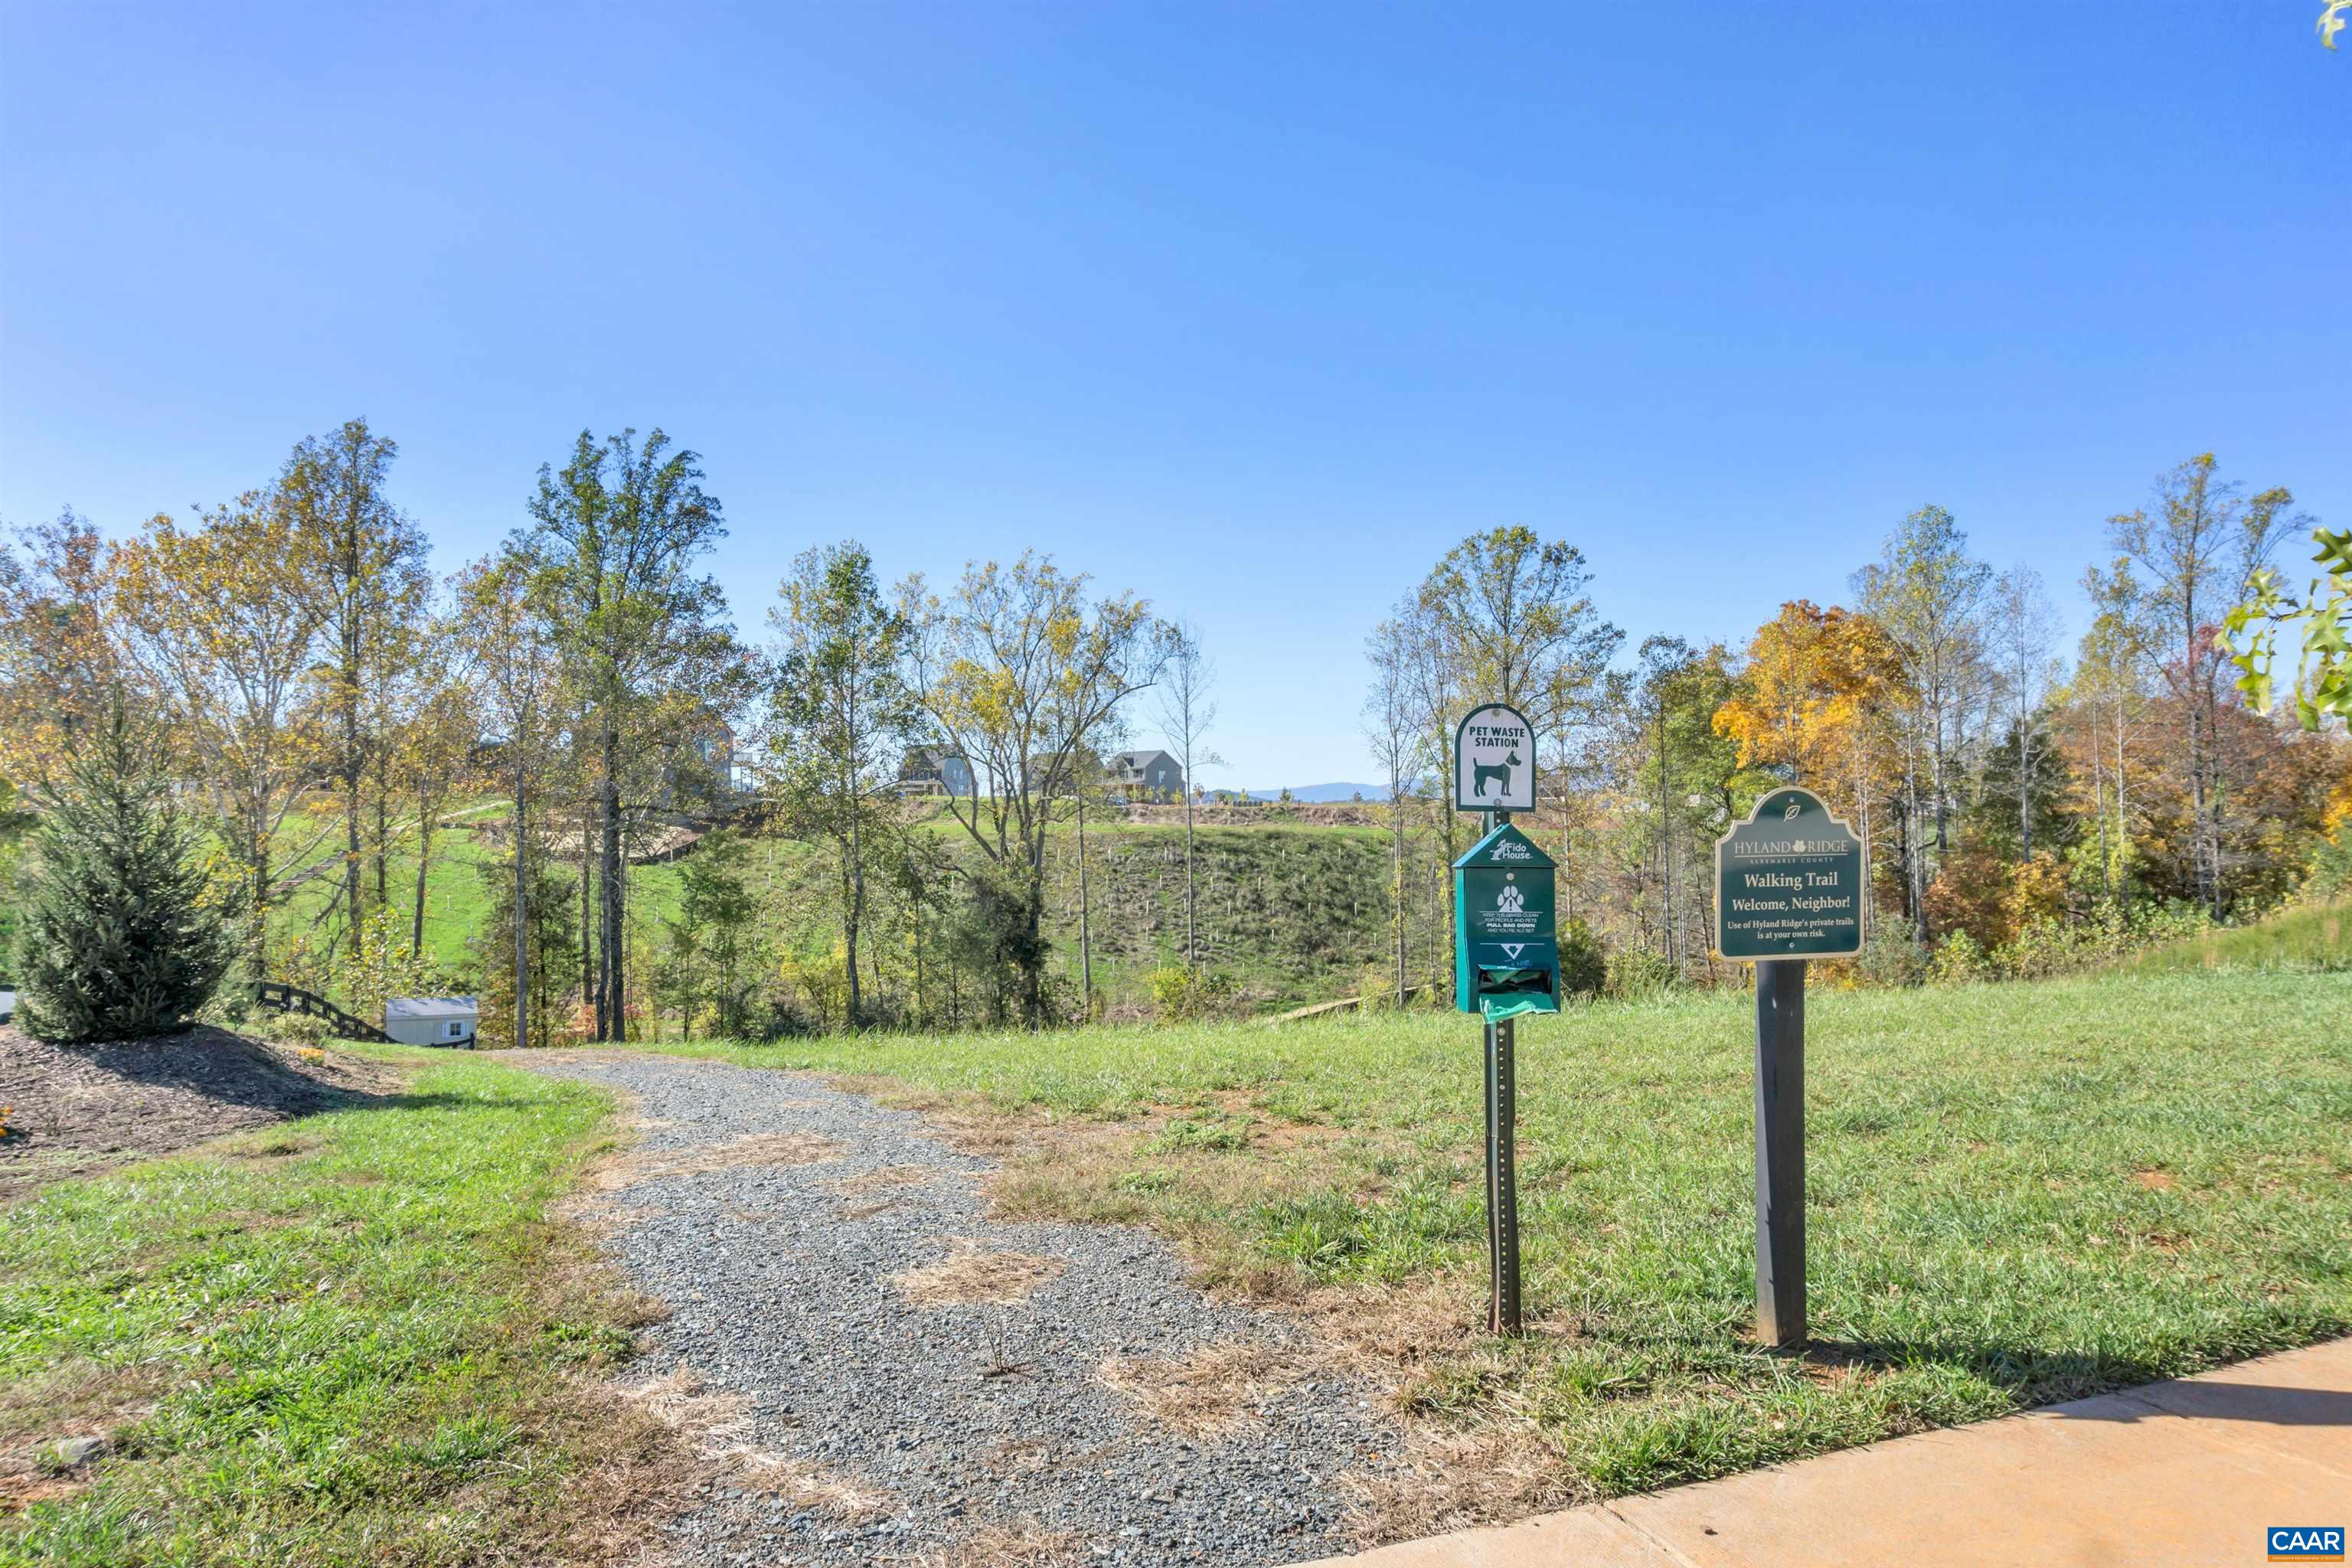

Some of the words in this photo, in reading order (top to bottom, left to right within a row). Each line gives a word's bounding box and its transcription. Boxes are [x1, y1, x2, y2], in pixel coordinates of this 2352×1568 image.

[1470, 727, 1488, 735] PET
[1491, 727, 1525, 737] WASTE
[1475, 737, 1518, 747] STATION
[1507, 843, 1526, 851] Fido
[1735, 841, 1791, 854] HYLAND
[1808, 840, 1848, 852] RIDGE
[1503, 851, 1531, 859] House
[1744, 873, 1802, 890] Walking
[1805, 871, 1838, 886] Trail
[1732, 898, 1788, 912] Welcome,
[1792, 896, 1851, 912] Neighbor!
[1728, 921, 1741, 929] Use
[1743, 921, 1751, 929] of
[1753, 920, 1779, 930] Hyland
[1781, 920, 1808, 929] Ridge's
[1810, 919, 1834, 928] private
[1836, 917, 1854, 926] trails
[1774, 932, 1790, 941] your
[1810, 929, 1825, 937] risk.
